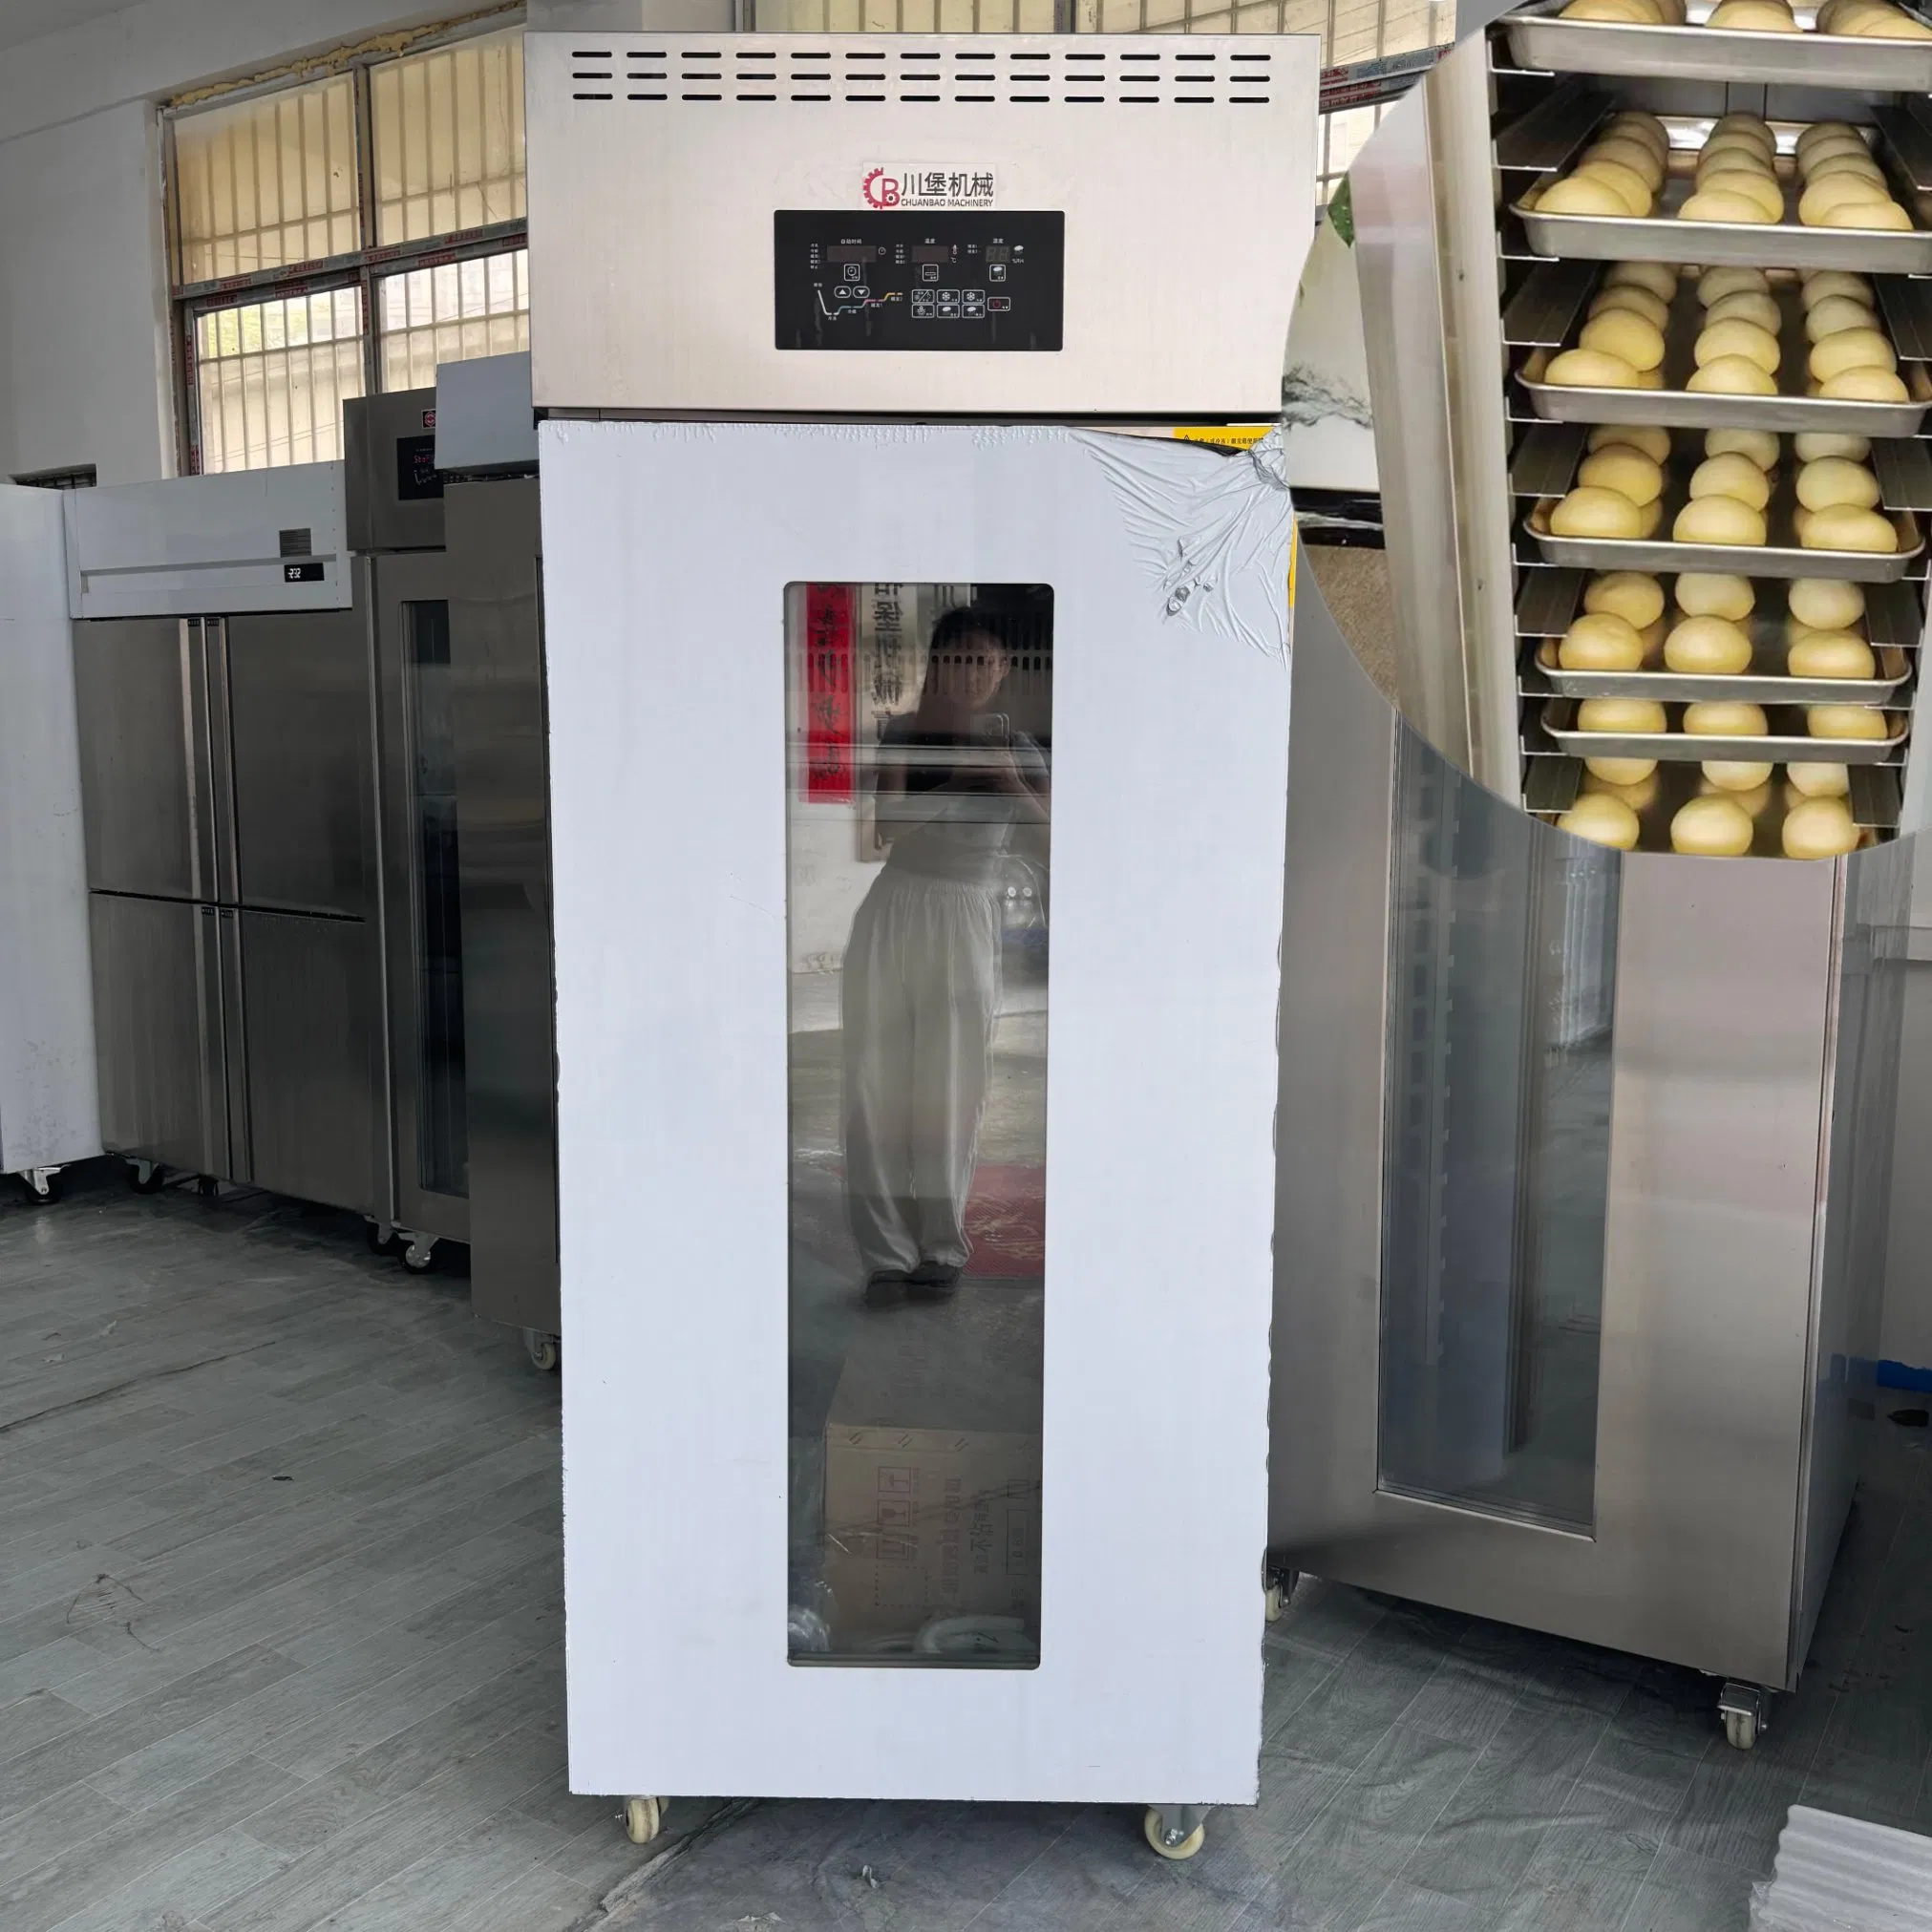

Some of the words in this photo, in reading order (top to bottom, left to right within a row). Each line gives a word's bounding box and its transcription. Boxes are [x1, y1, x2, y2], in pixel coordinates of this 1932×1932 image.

[902, 172, 994, 198] 川堡机械
[901, 198, 945, 207] CHUANBAO
[947, 199, 994, 207] MACHINERY
